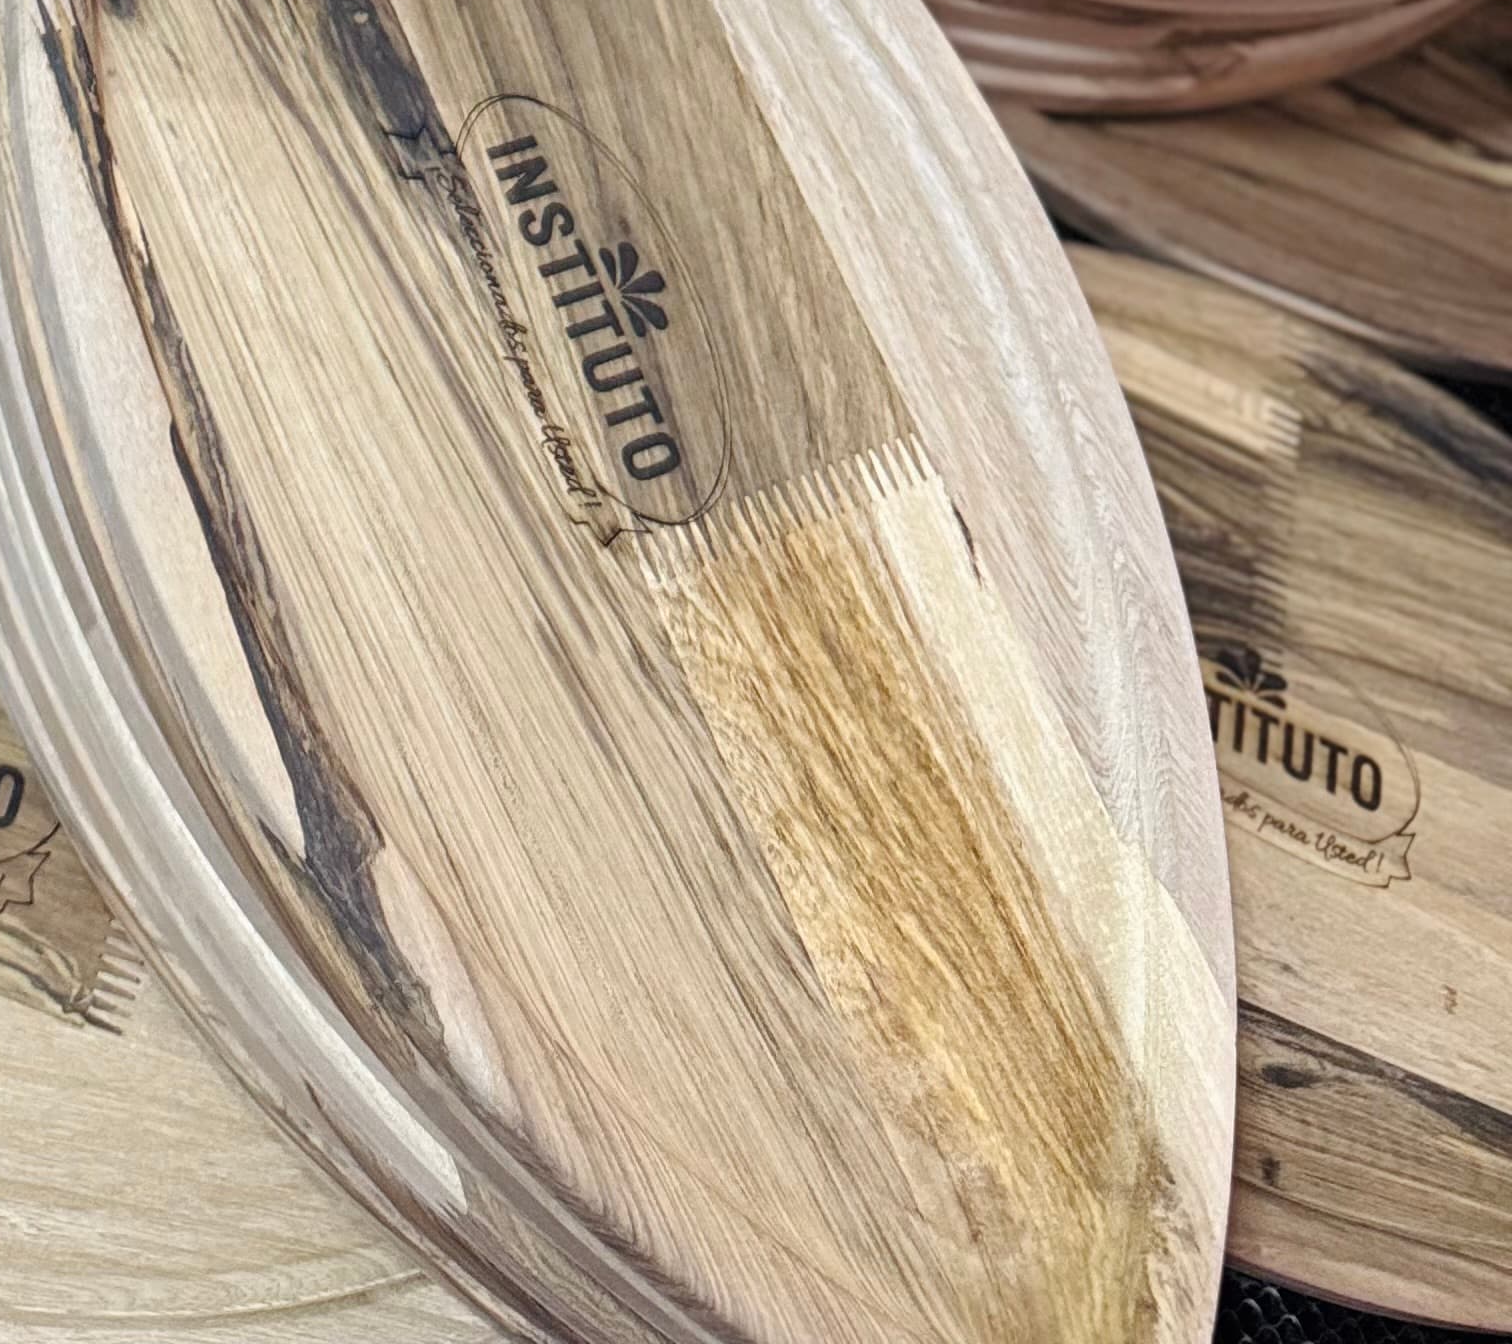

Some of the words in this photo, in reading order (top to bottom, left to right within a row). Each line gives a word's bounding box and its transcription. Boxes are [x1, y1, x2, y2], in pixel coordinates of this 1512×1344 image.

[486, 134, 682, 482] INSTITUTO
[502, 352, 548, 419] para
[1204, 686, 1383, 812] TITUTO
[1257, 813, 1311, 846] para
[1314, 830, 1385, 874] Usted!
